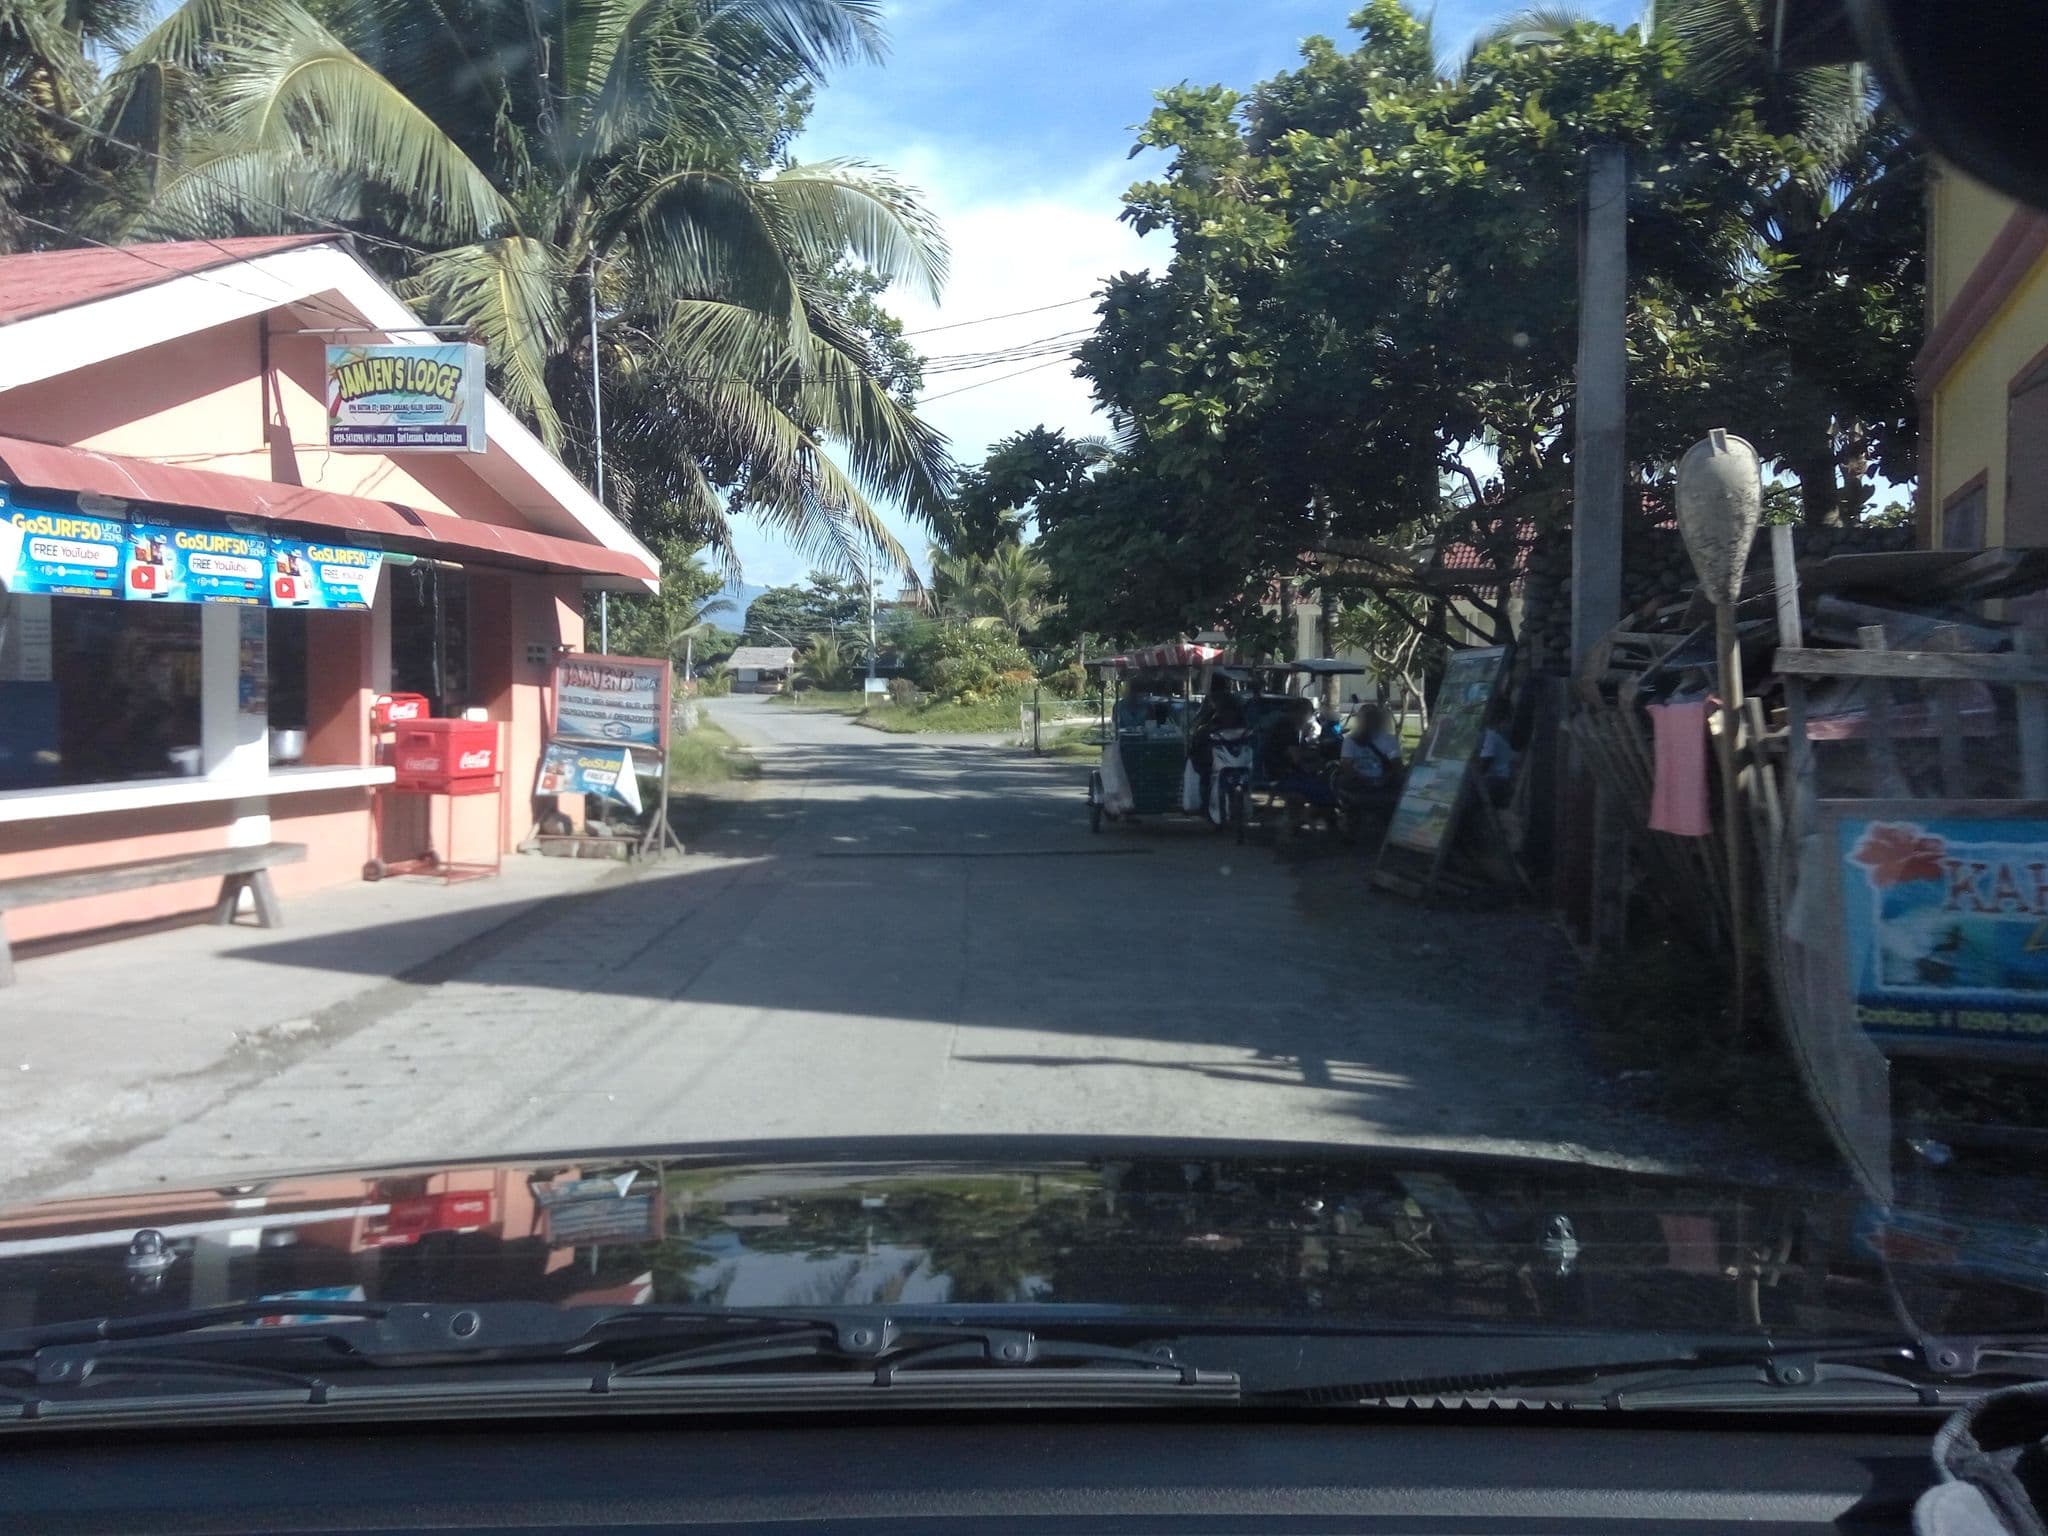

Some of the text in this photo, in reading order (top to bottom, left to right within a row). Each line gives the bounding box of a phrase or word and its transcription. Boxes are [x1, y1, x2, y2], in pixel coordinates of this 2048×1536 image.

[407, 357, 462, 402] LODGE
[12, 513, 101, 541] GoSURF50
[34, 543, 100, 560] FREE YouTube
[175, 531, 248, 555] GoSURF50
[193, 558, 211, 570] FREE
[307, 545, 366, 565] GoSURF50
